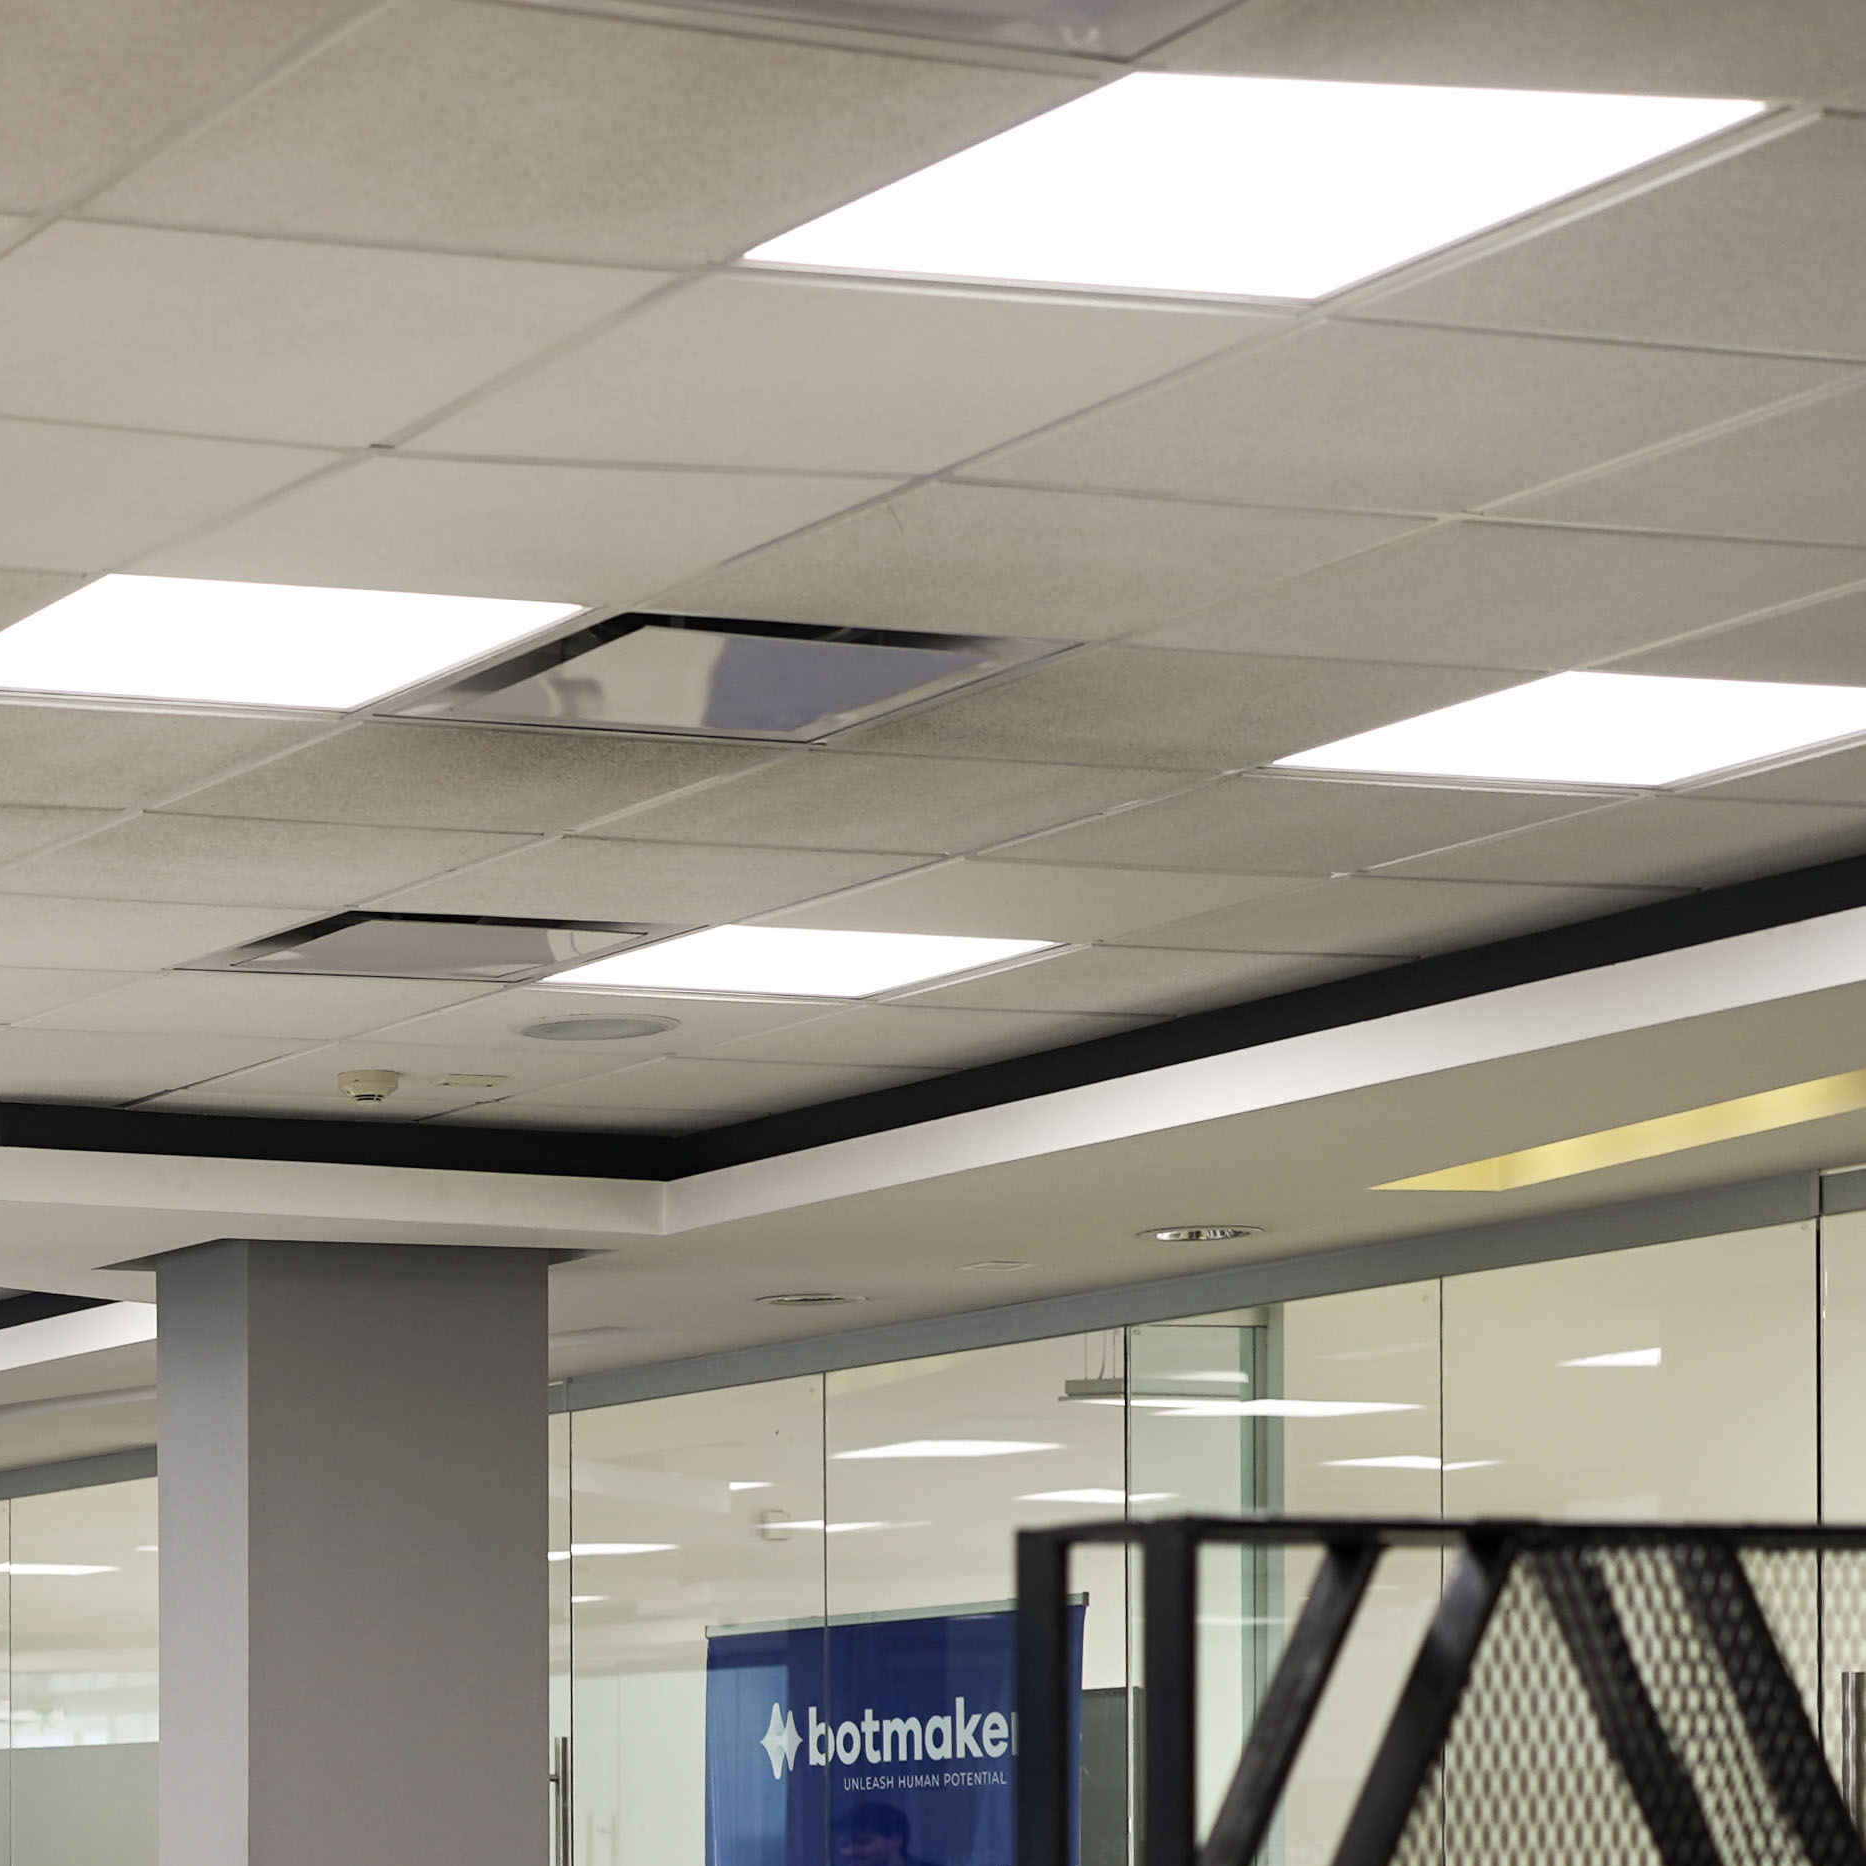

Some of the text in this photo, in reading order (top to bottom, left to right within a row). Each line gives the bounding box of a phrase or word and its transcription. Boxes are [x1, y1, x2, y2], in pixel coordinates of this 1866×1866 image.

[843, 1770, 1008, 1791] UNLEASH HUMAN POTENTIAL
